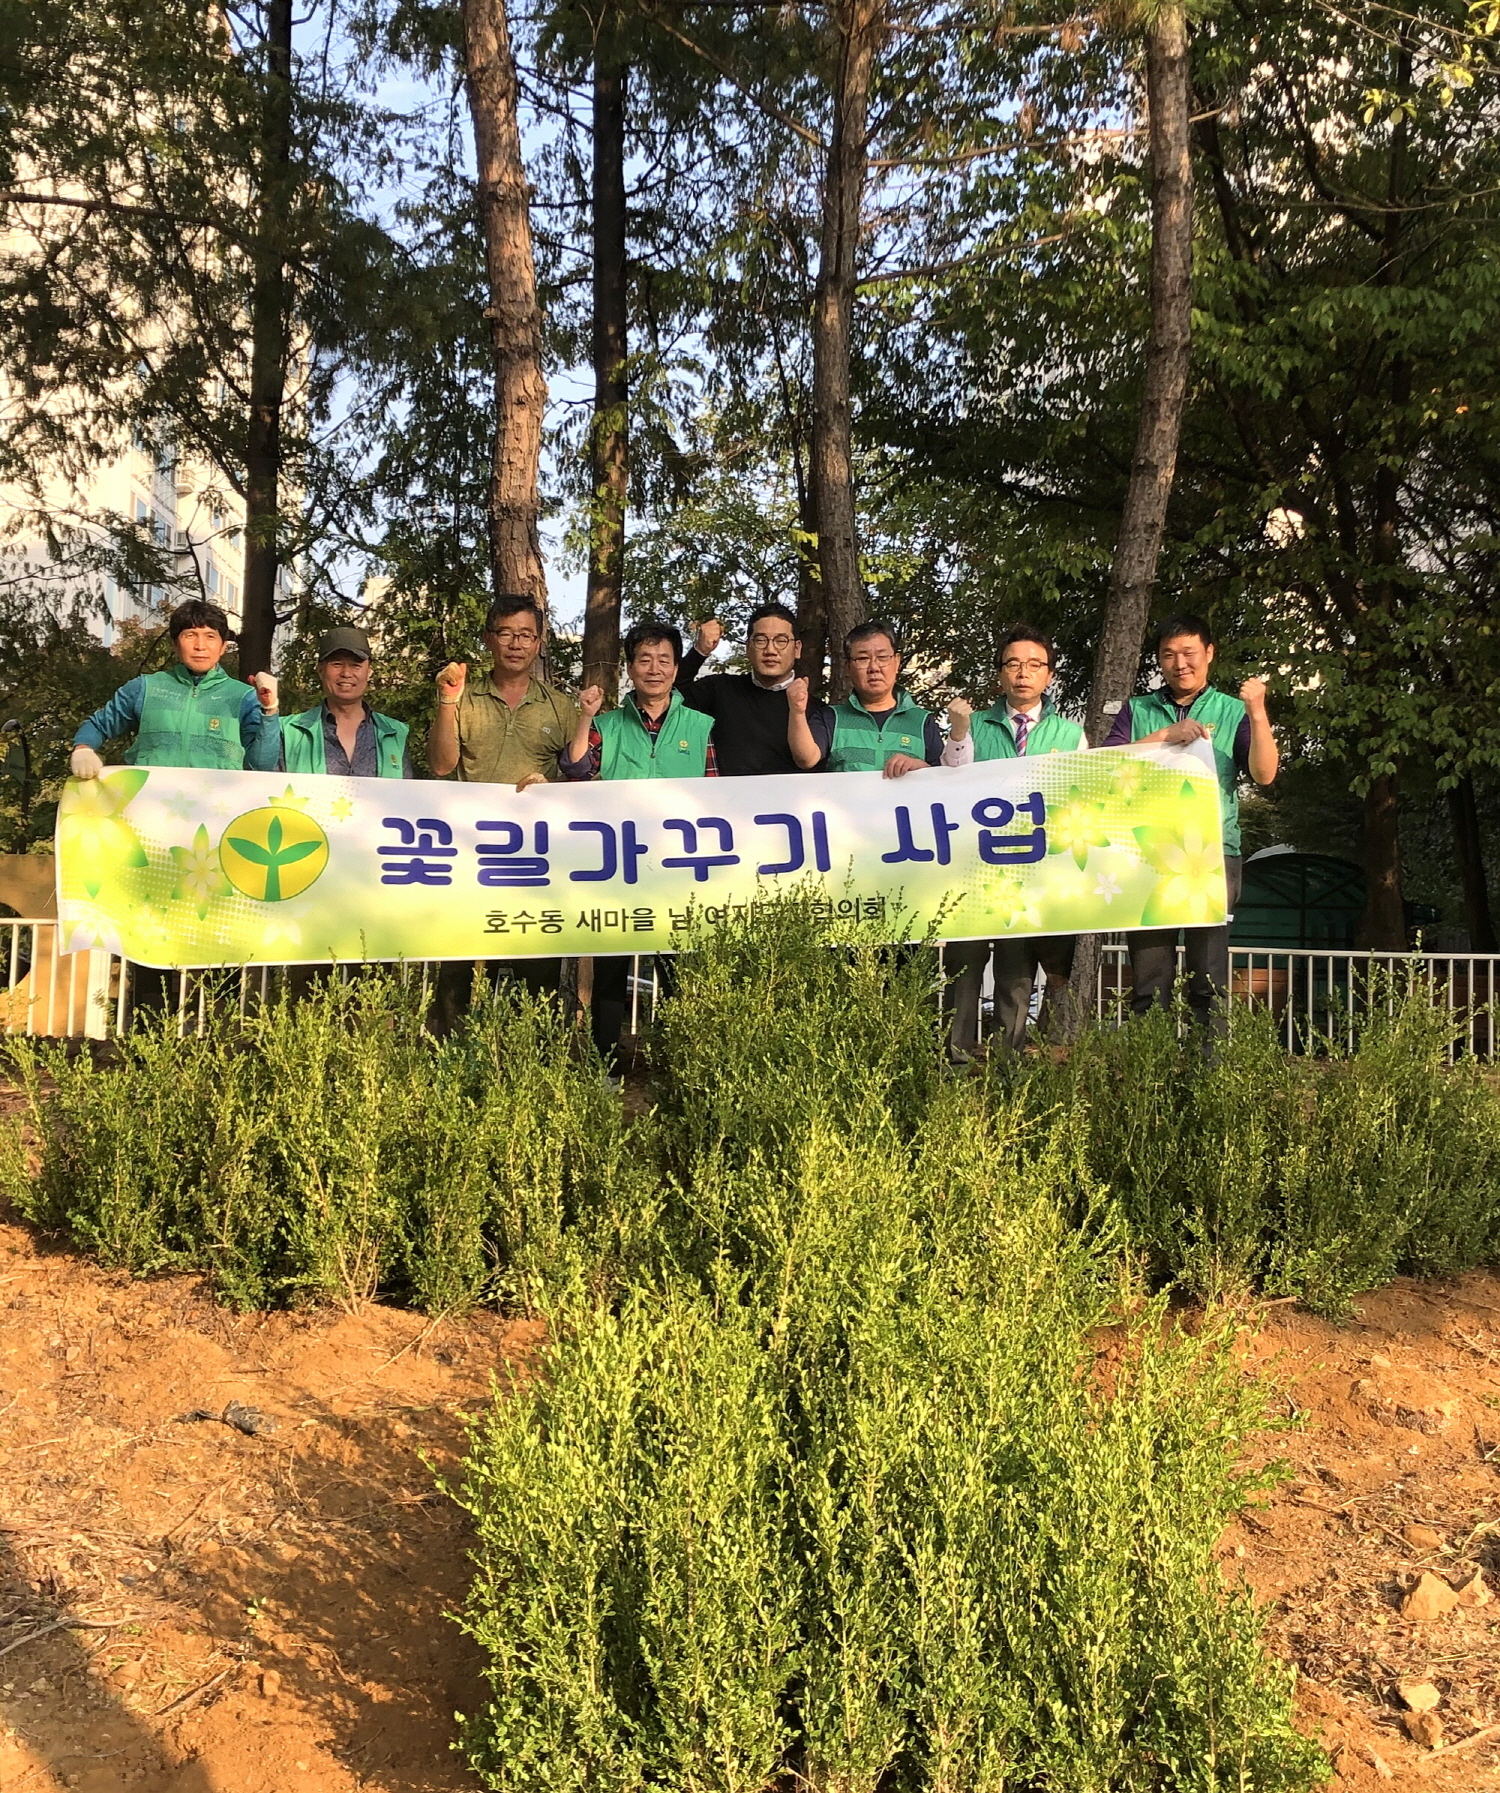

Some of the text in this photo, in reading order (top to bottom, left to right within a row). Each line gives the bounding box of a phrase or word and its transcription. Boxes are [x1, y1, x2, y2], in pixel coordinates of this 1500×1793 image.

[377, 792, 1046, 887] 꽃길가꾸기 사업
[483, 910, 565, 934] 호수동
[576, 907, 657, 932] 새마을
